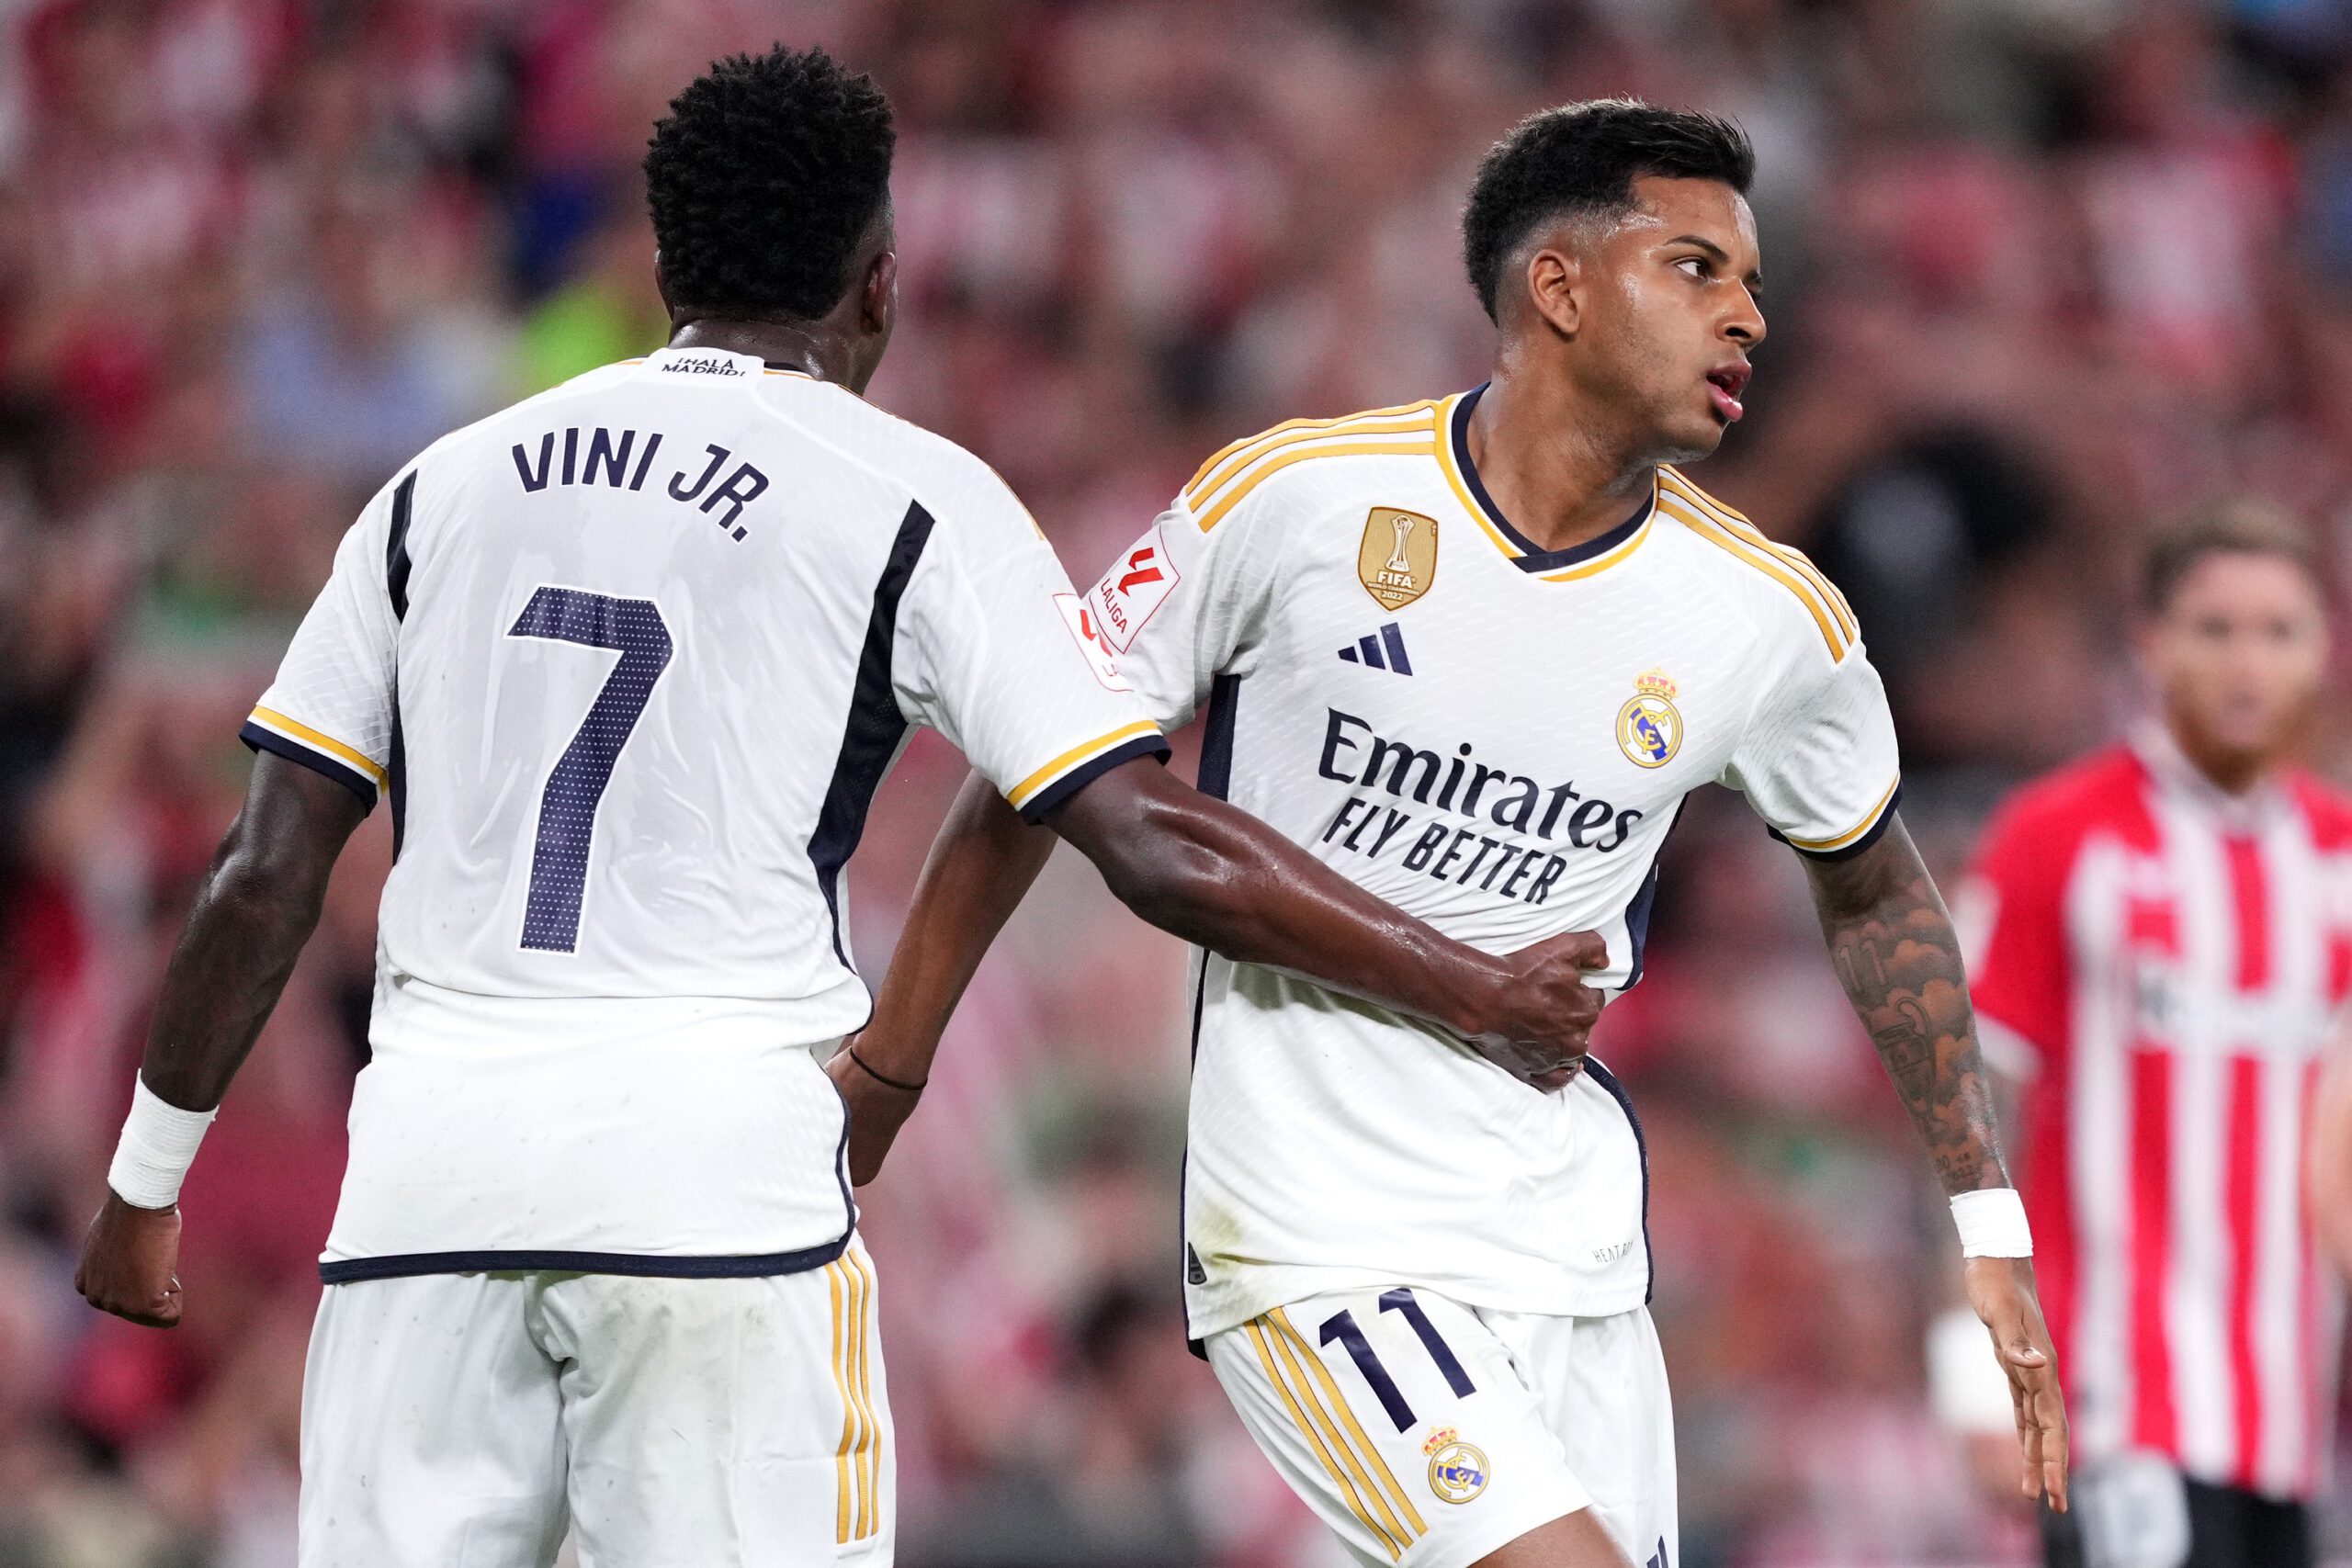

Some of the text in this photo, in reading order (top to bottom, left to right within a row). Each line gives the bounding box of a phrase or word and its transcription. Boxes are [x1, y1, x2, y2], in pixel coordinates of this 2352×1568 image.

[662, 364, 746, 377] MADRID!
[512, 427, 770, 543] VINI JR.
[1100, 577, 1128, 635] LALIGA
[1377, 570, 1413, 589] FIFA
[1381, 590, 1404, 602] 2022
[504, 583, 677, 956] 7
[1318, 706, 1644, 853] Emirates
[1322, 796, 1567, 907] FLY BETTER
[1318, 1286, 1477, 1435] 11
